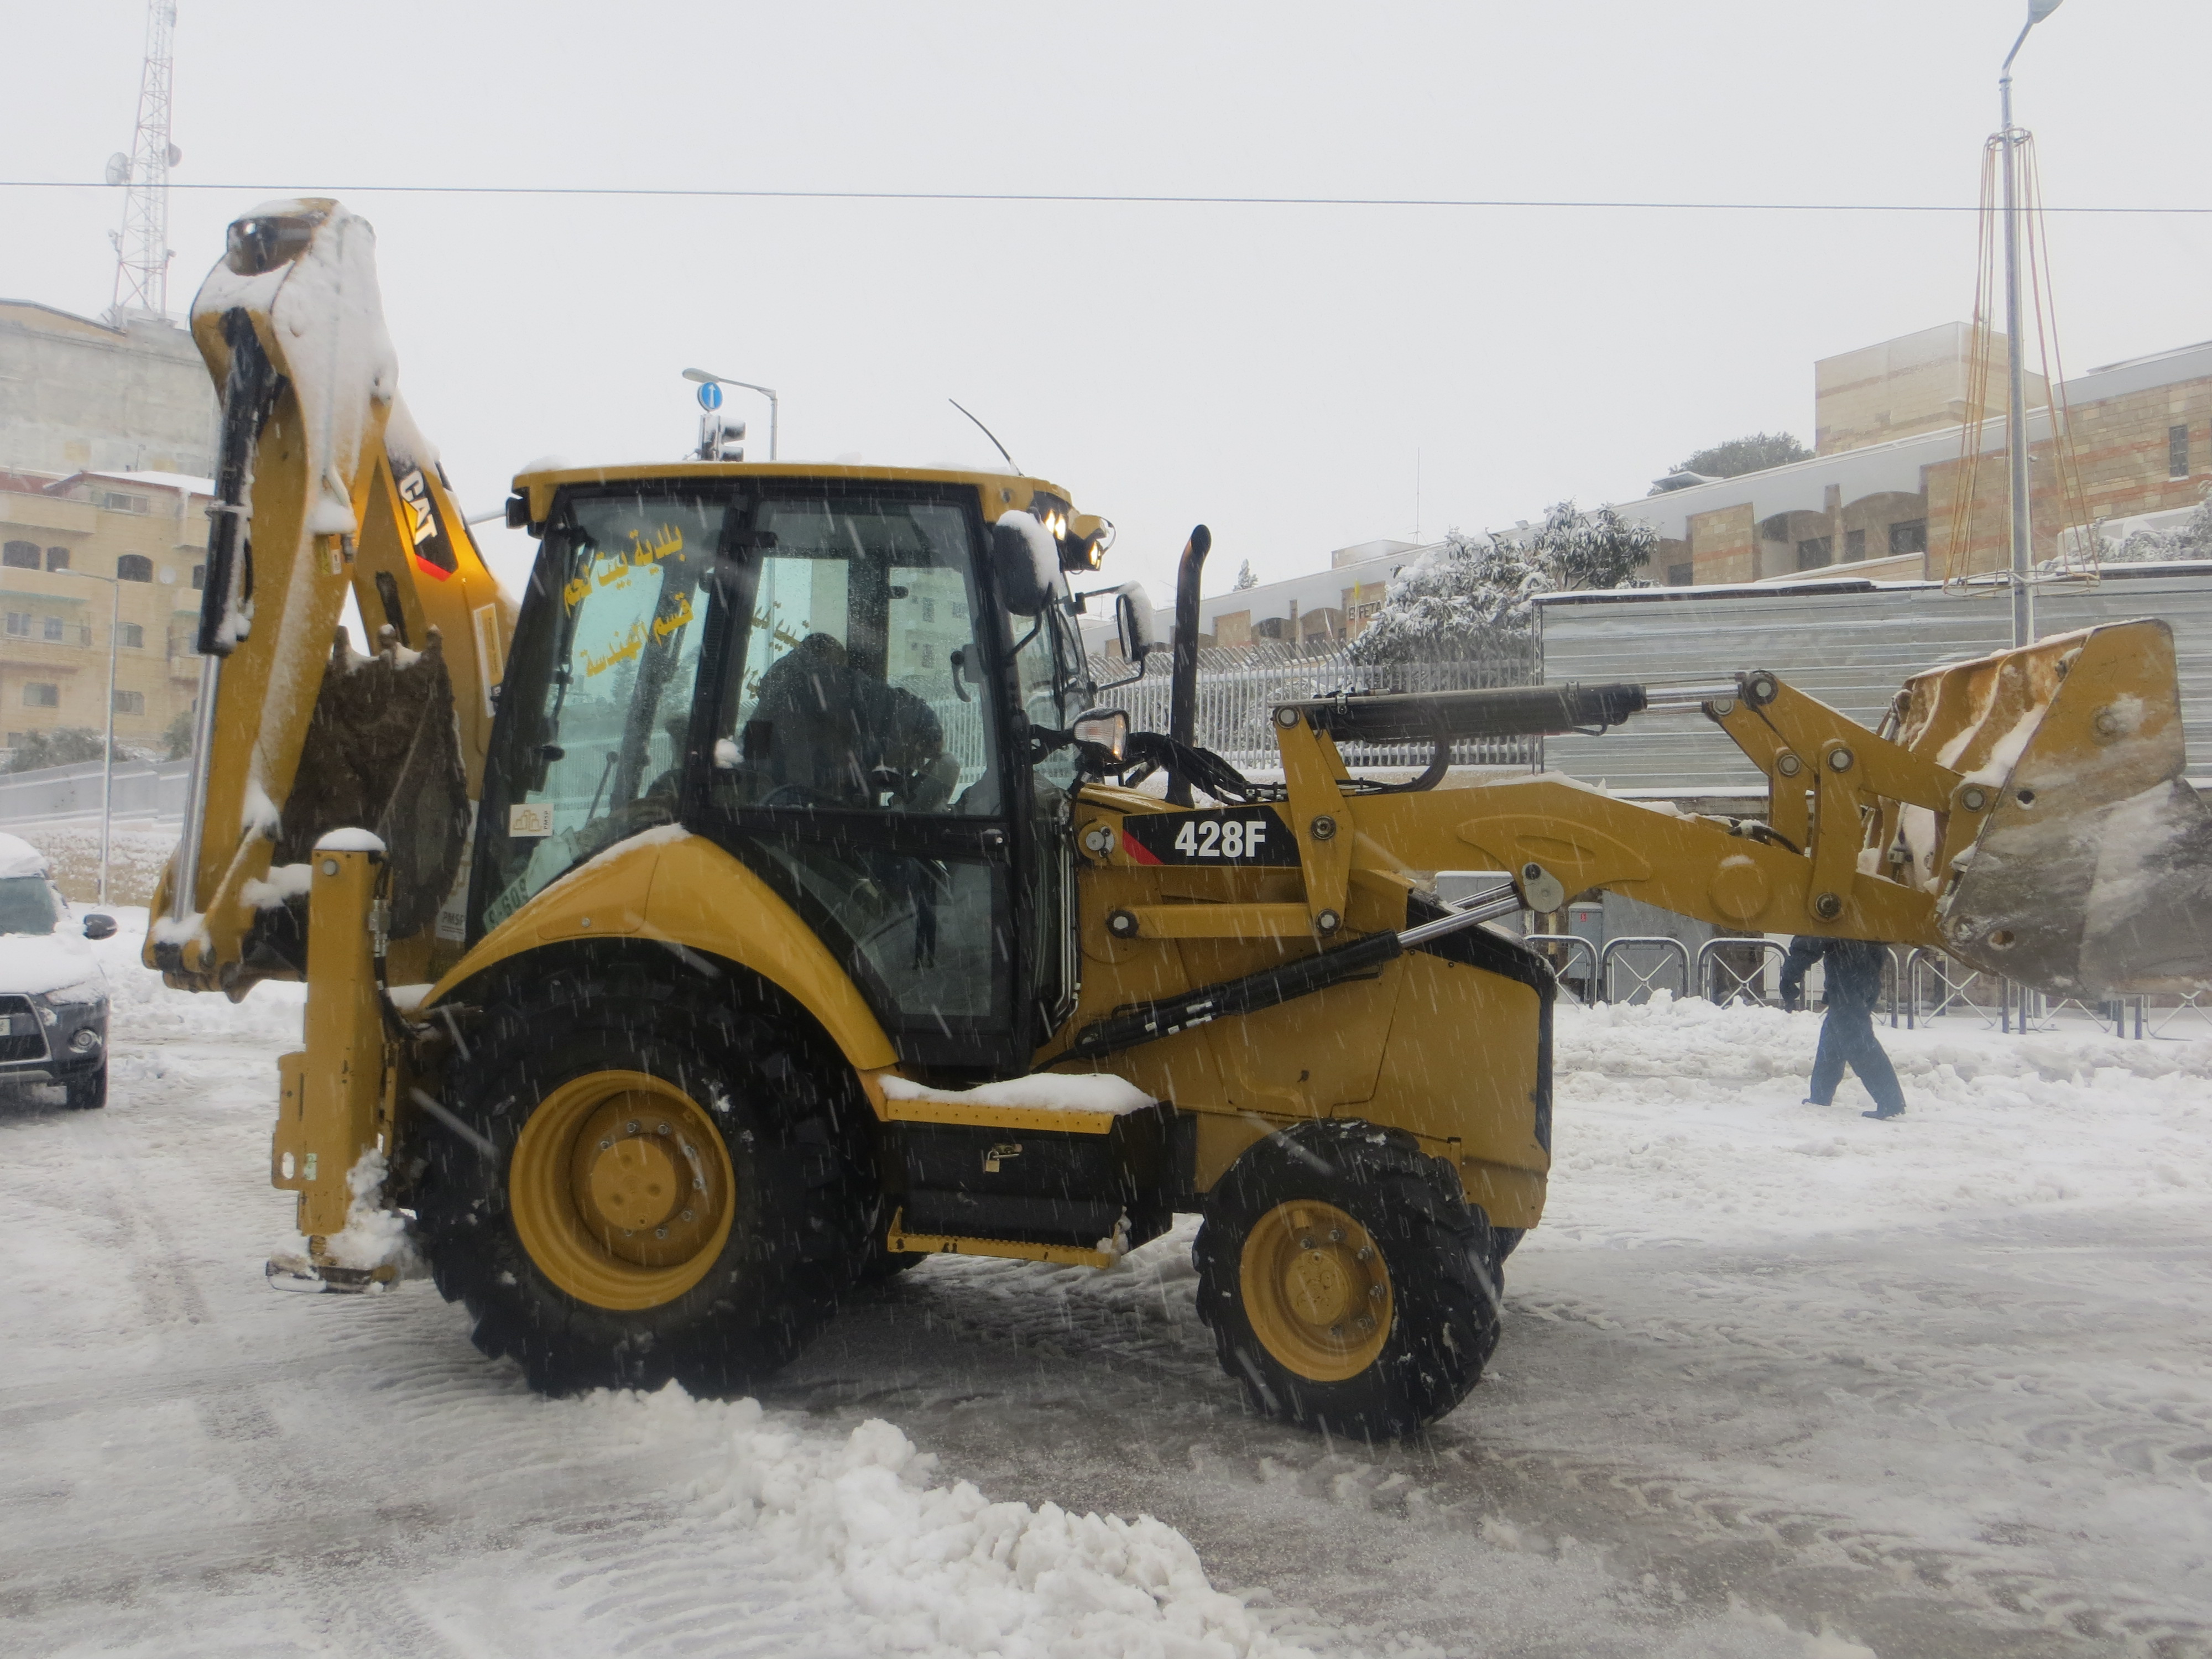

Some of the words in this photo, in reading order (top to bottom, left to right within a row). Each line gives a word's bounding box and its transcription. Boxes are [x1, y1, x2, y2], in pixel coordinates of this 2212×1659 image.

[400, 470, 438, 545] CAT
[595, 550, 632, 590] بيت
[628, 523, 686, 575] بلدية
[564, 564, 592, 618] لحم
[654, 592, 694, 646] قسم
[579, 620, 649, 677] الهندسة
[1175, 821, 1266, 858] 428F
